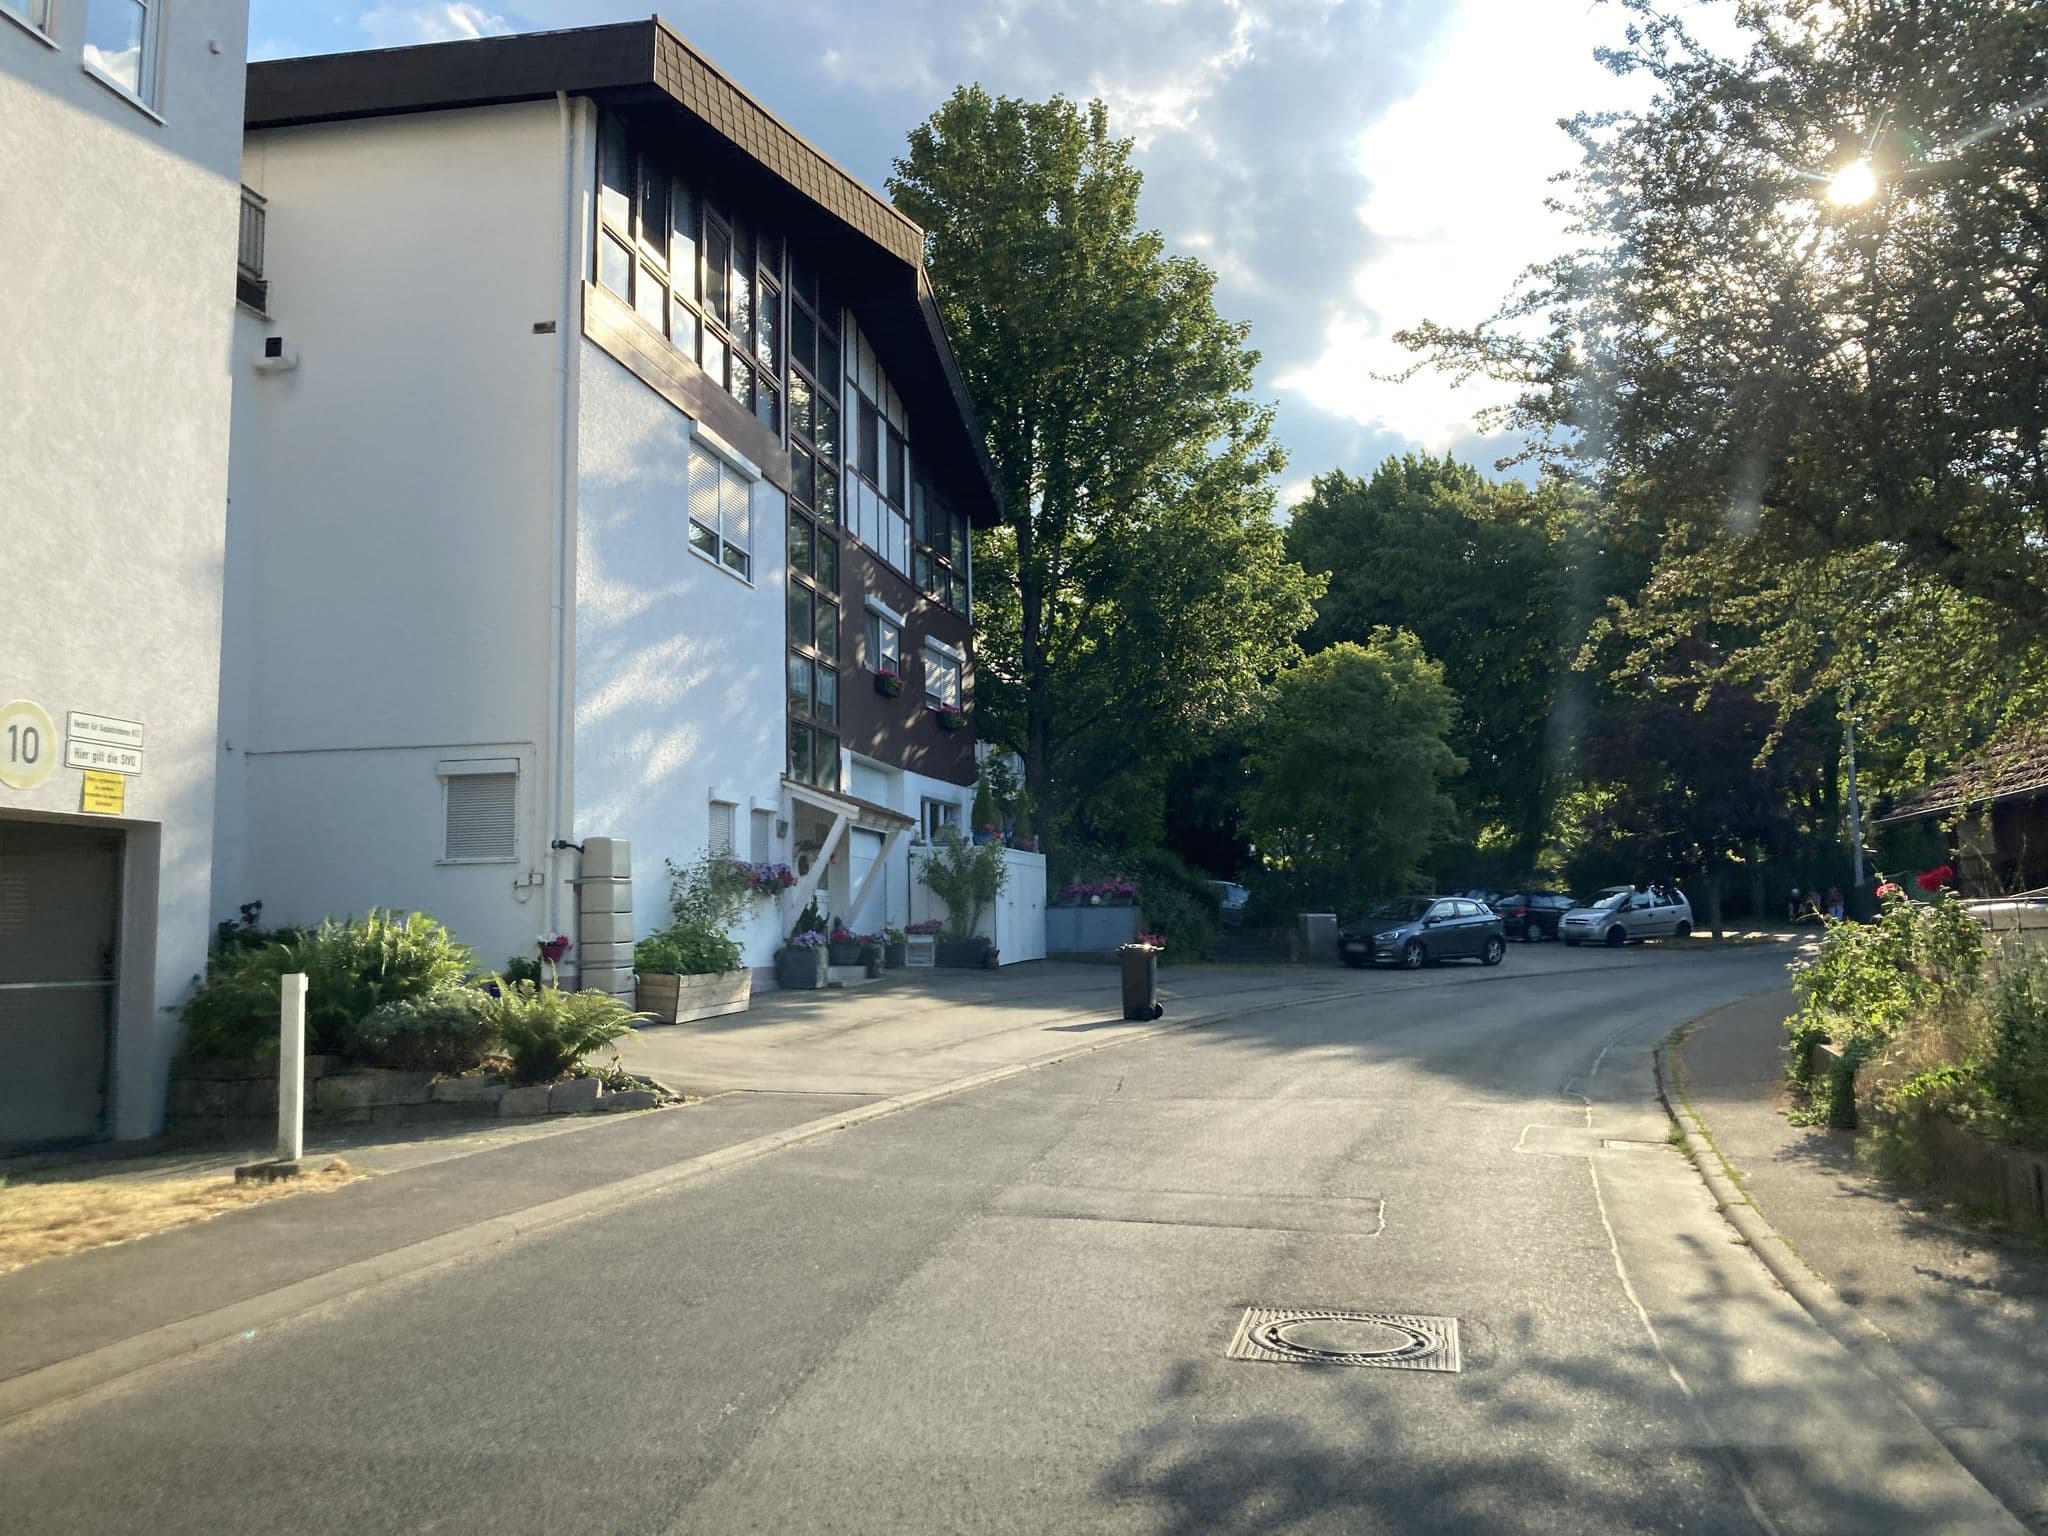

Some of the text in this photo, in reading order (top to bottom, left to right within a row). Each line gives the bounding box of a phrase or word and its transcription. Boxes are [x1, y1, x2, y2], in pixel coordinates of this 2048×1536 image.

[8, 724, 40, 764] 10
[74, 747, 89, 760] Hier
[92, 750, 105, 764] gilt
[107, 752, 118, 764] die
